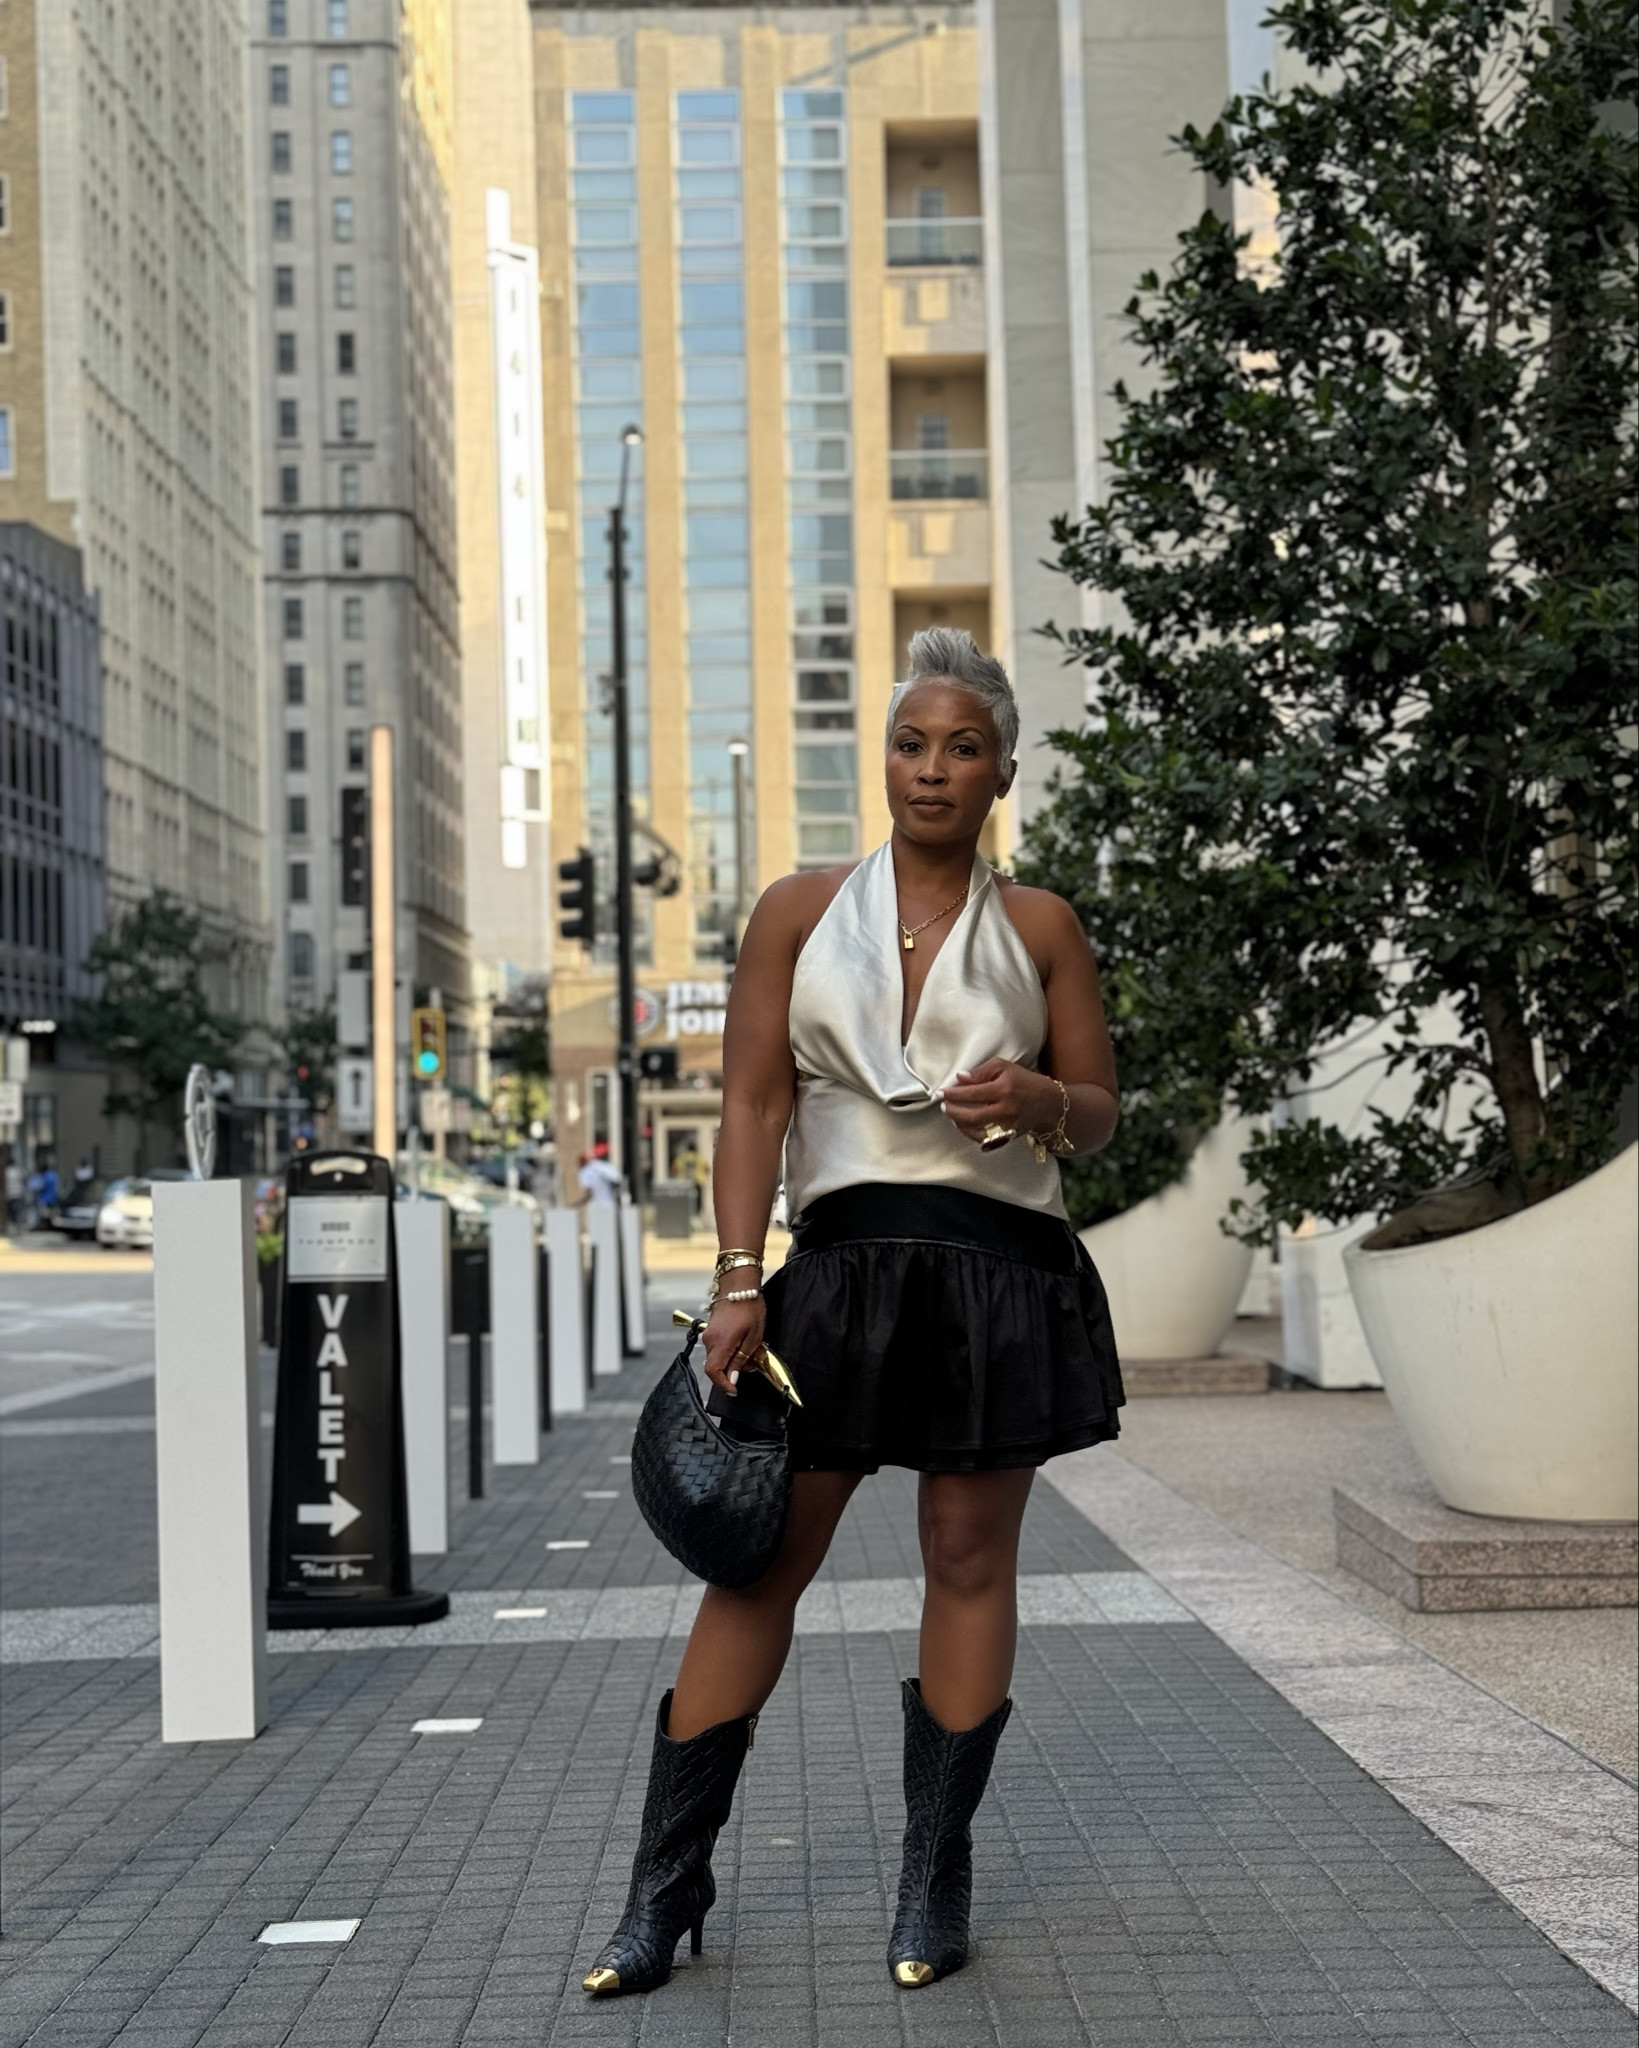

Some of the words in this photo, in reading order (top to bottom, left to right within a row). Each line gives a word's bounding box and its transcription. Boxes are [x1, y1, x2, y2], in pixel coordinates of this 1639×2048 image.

[316, 1294, 349, 1483] VALET
[300, 1562, 336, 1577] Thank
[339, 1562, 364, 1580] You
